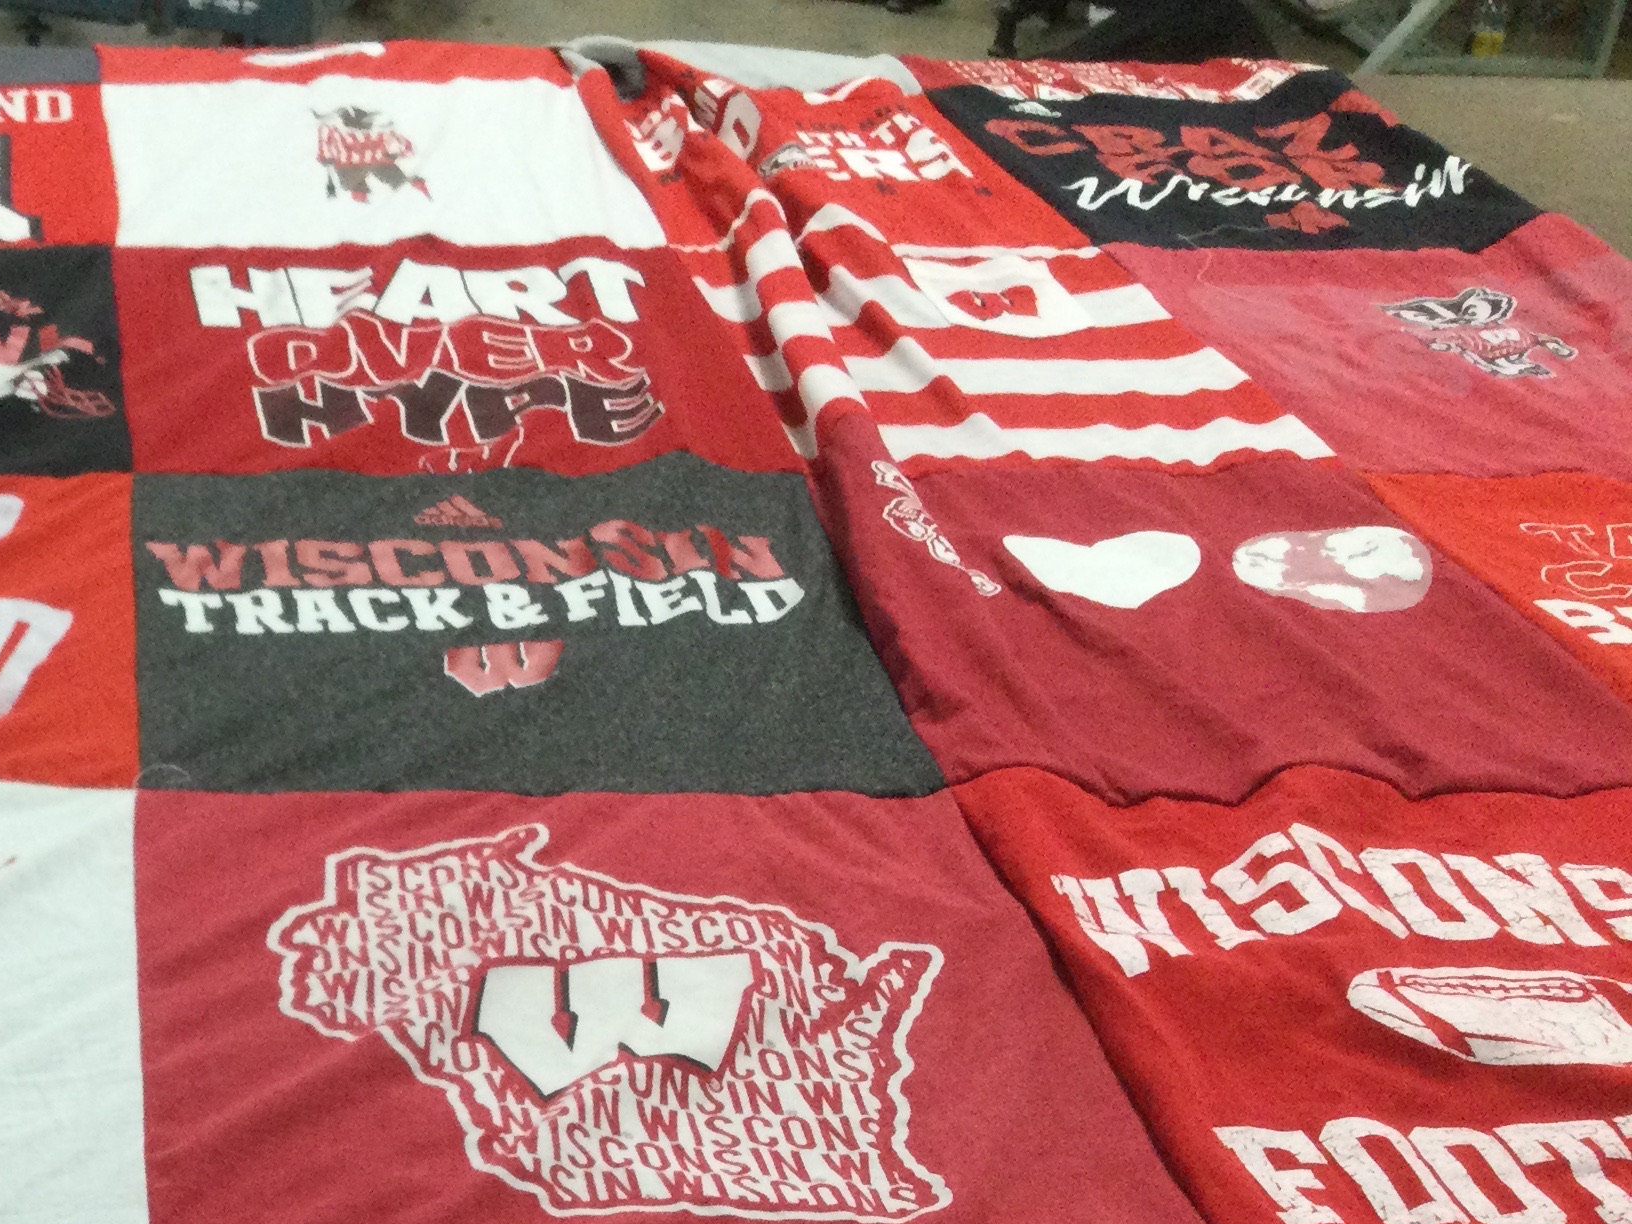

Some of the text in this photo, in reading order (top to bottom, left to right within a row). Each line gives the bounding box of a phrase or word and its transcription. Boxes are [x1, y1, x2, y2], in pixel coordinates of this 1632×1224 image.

[189, 256, 646, 328] HEART
[246, 310, 651, 388] OVER
[252, 367, 666, 447] HYPE
[145, 519, 786, 591] WISCONSIN
[158, 569, 807, 634] TRACK & FIELD
